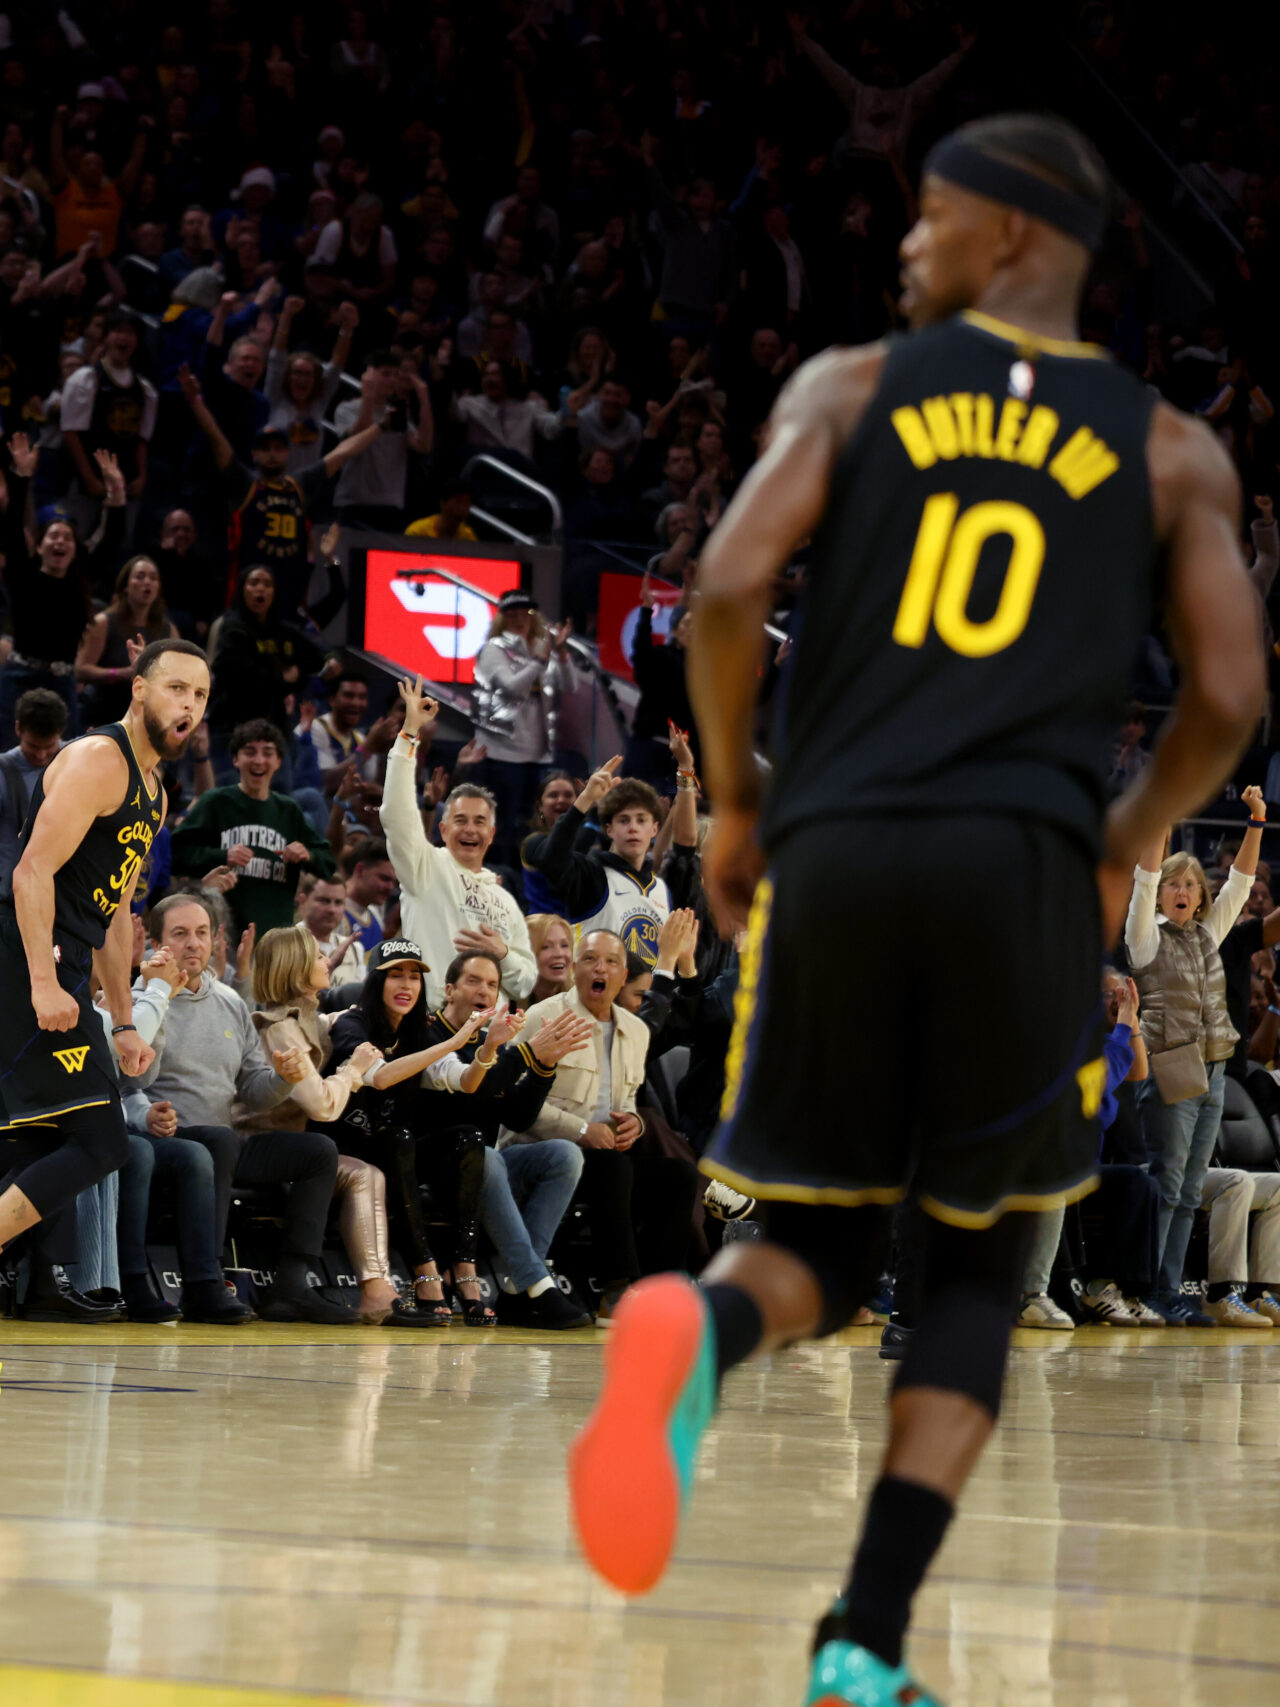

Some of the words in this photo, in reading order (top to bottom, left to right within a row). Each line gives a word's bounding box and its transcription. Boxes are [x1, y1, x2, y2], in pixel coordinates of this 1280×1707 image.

[890, 391, 1060, 470] BUTLER
[264, 512, 296, 539] 30
[891, 491, 1047, 659] 10
[110, 846, 142, 895] 30
[621, 906, 647, 922] GOLDEN
[641, 923, 656, 942] 30
[1179, 1281, 1201, 1295] ASE
